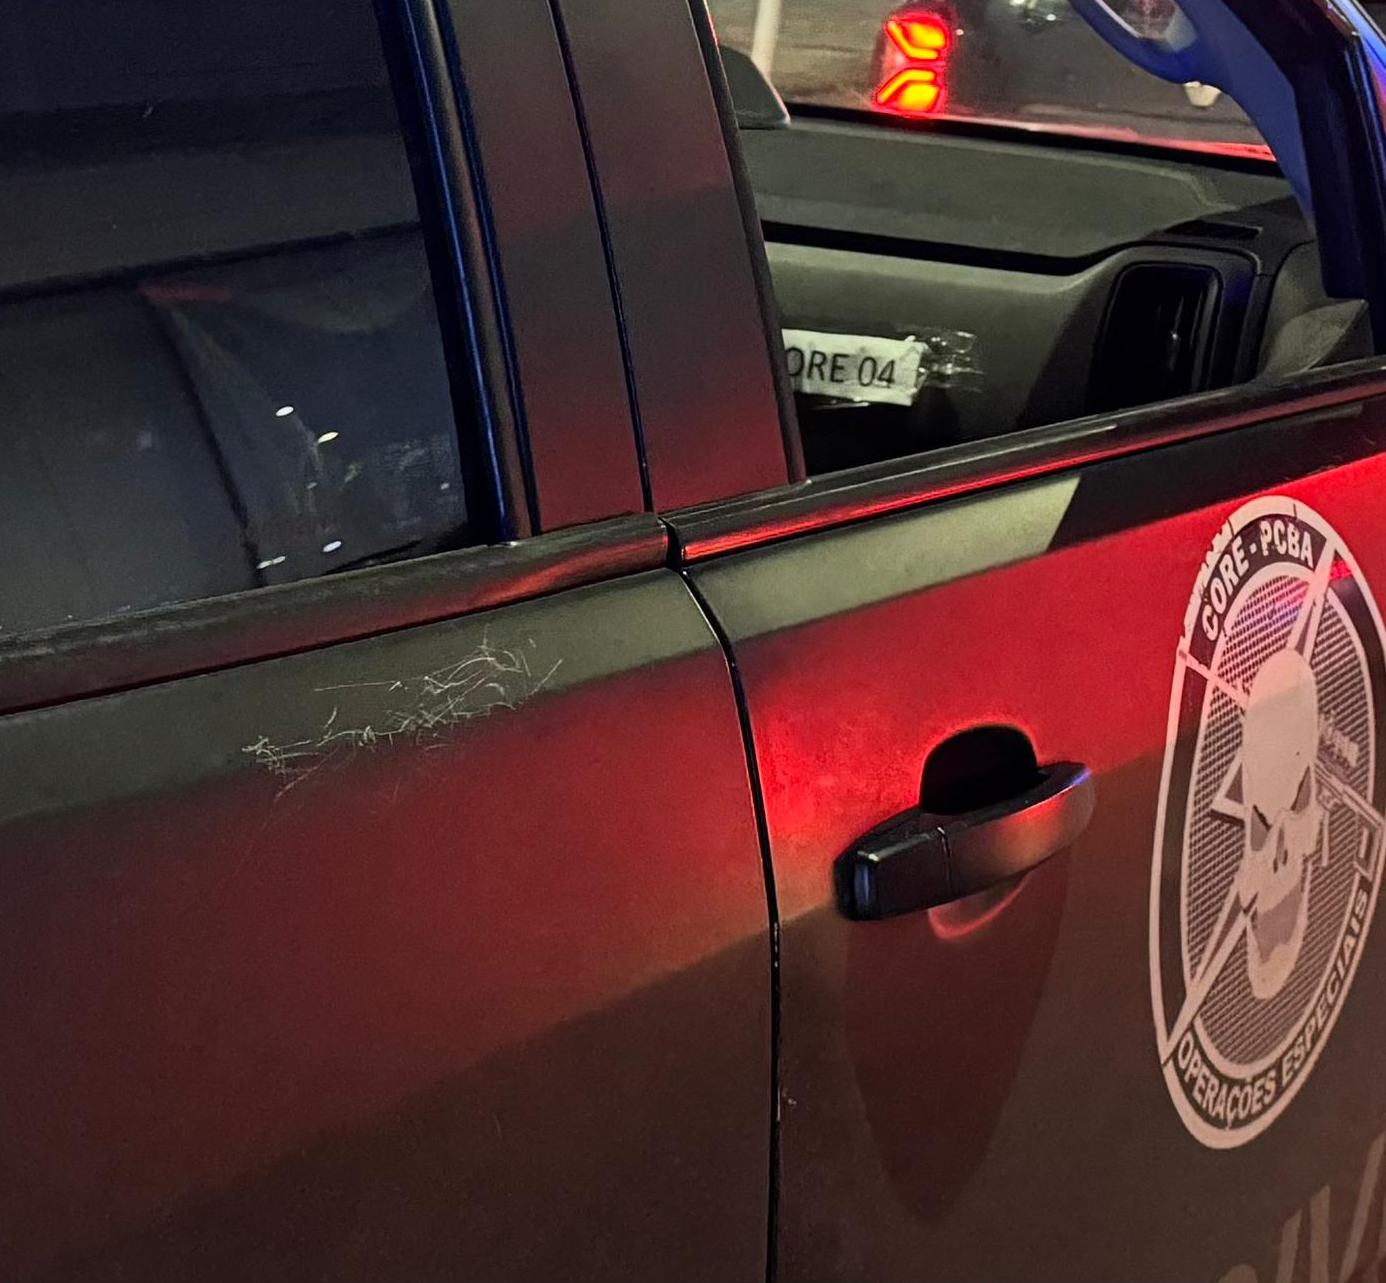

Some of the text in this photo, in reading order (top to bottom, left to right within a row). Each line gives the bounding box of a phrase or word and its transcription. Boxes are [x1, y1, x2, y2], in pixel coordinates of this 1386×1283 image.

[858, 356, 897, 389] 04
[1201, 535, 1250, 642] CORE
[1259, 519, 1314, 568] PCBA
[1281, 888, 1368, 1087] ESPECIAIS
